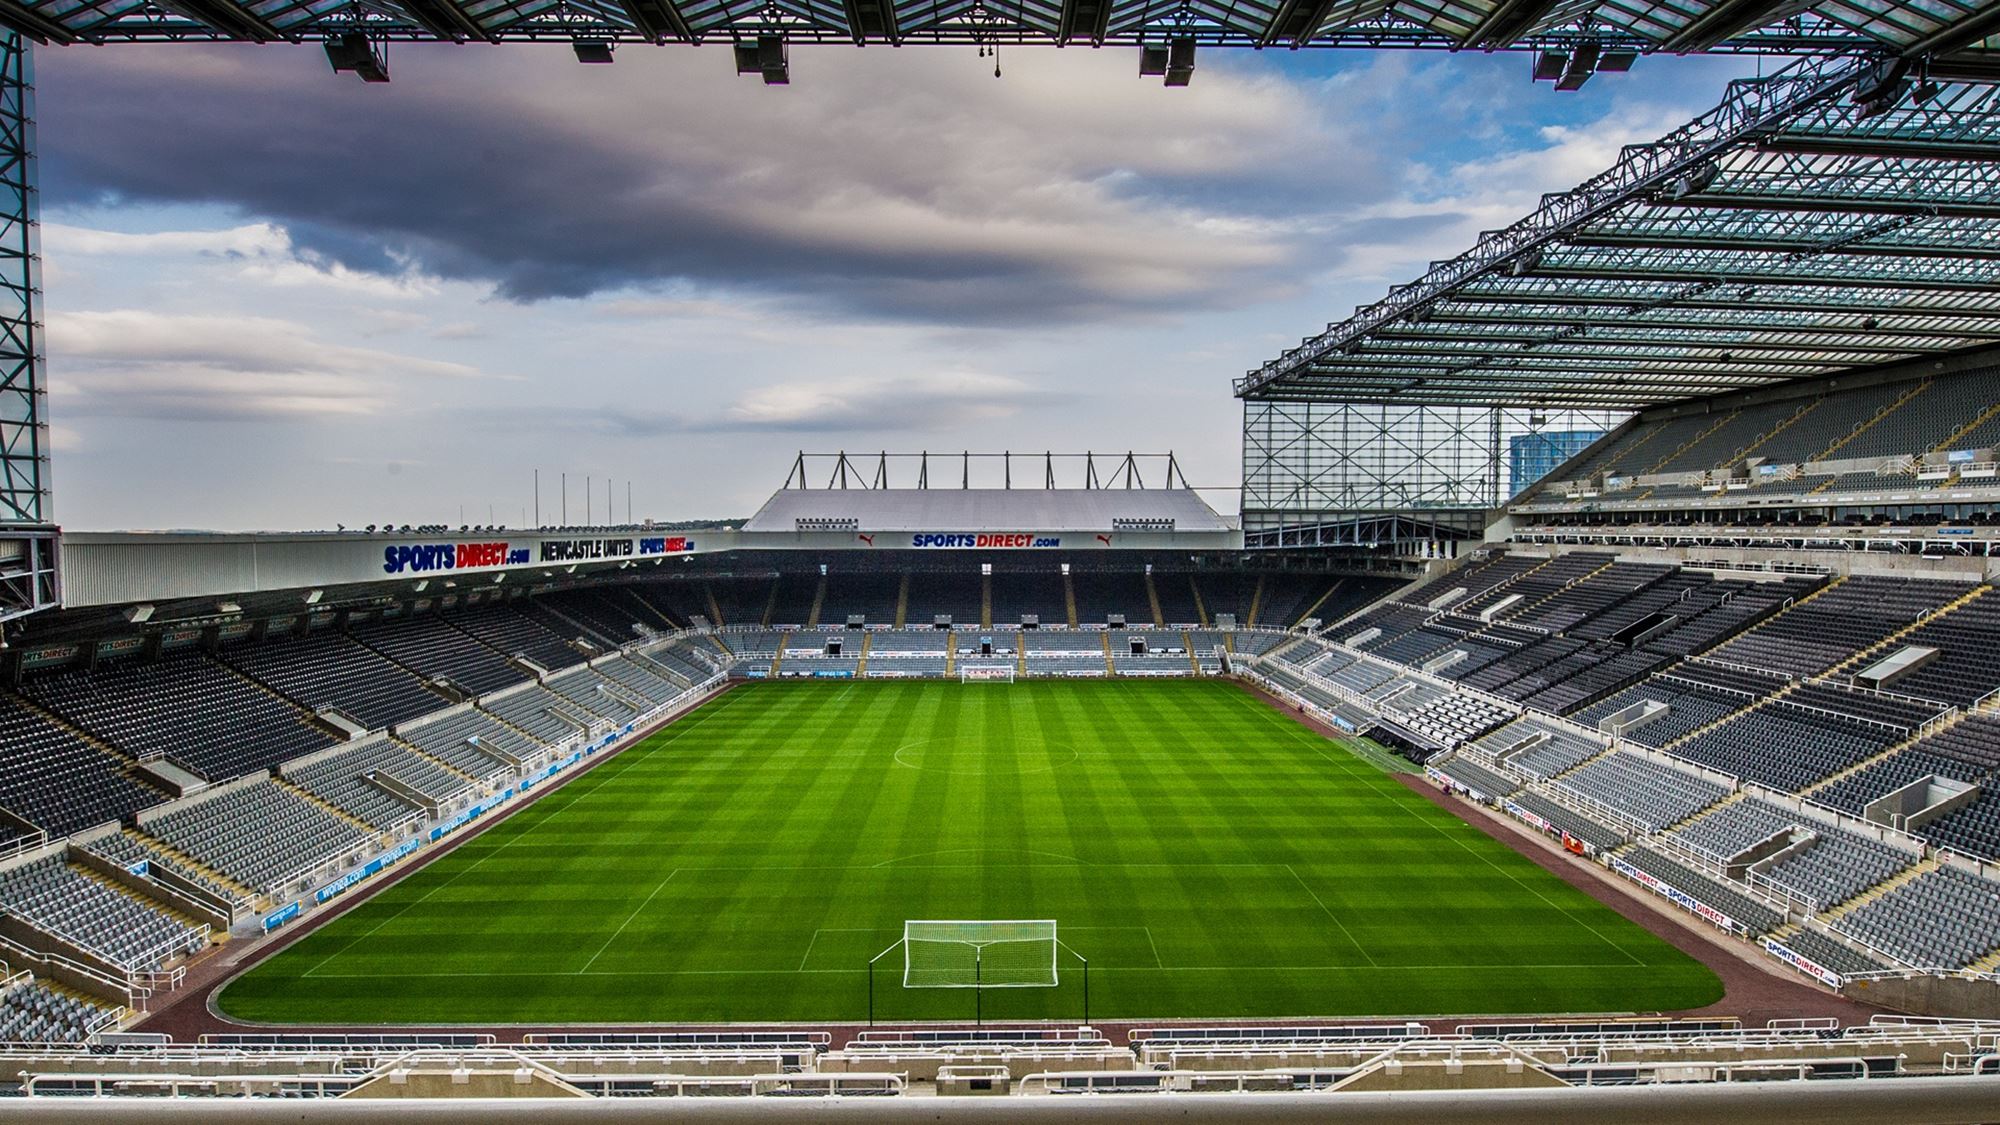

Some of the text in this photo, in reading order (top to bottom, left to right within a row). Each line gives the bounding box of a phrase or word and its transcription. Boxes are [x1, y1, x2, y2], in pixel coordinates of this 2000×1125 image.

[540, 539, 633, 562] NEWCASTLE UNITED
[323, 868, 366, 898] wonga.com
[270, 904, 296, 923] wonga.com
